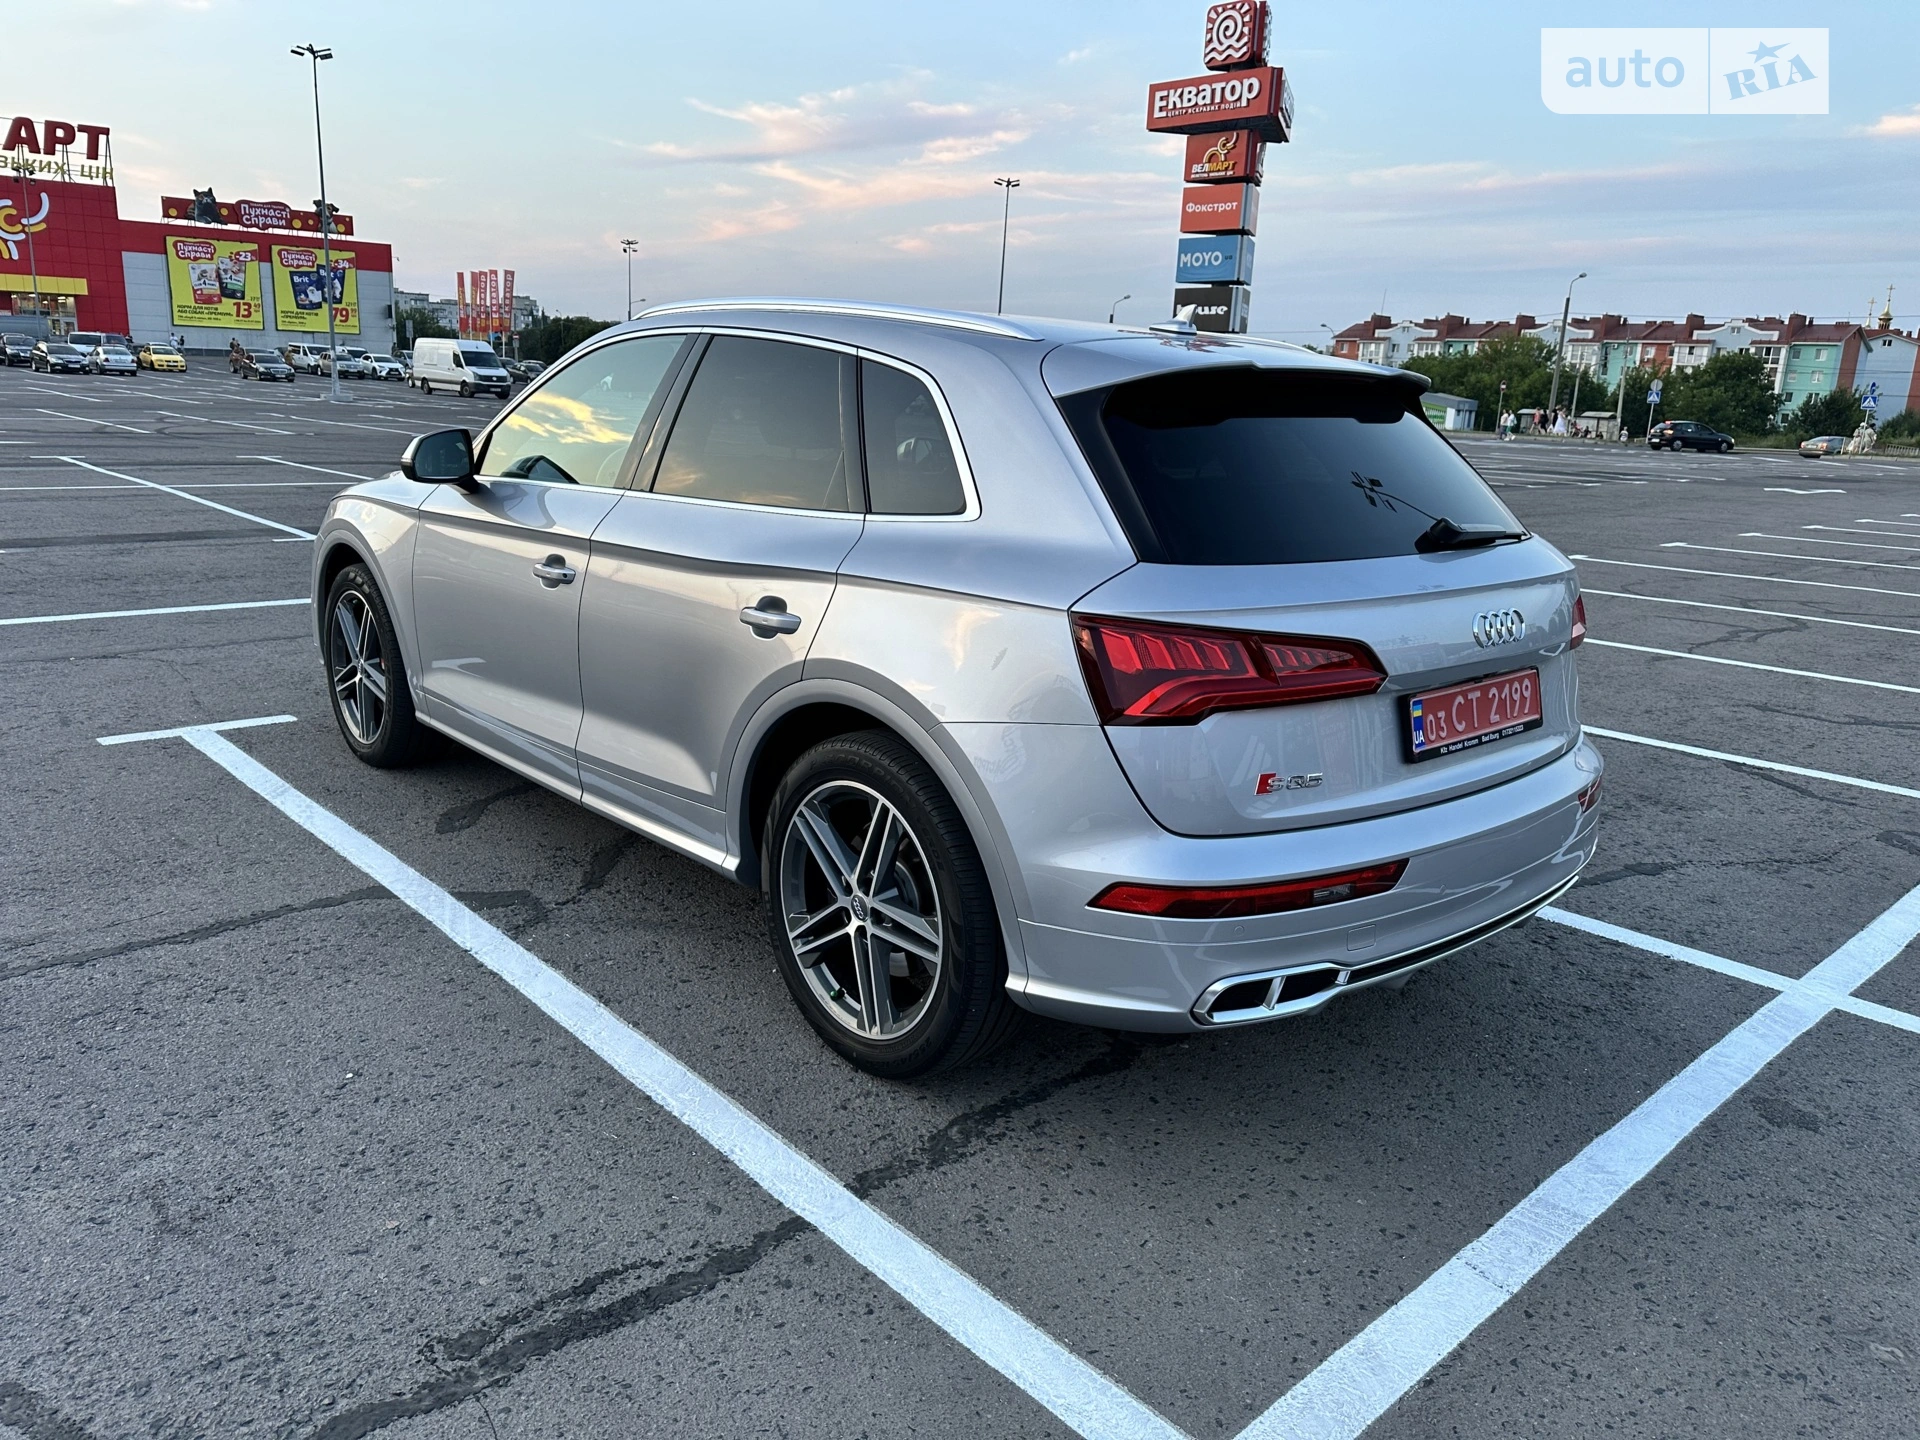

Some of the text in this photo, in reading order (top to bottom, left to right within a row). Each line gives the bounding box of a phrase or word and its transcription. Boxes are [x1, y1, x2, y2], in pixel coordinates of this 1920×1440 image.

[1153, 77, 1260, 118] Екватор
[1167, 109, 1186, 118] ЦЕНТР
[1187, 105, 1219, 114] ЯСКРАВИХ
[2, 116, 110, 160] АРТ
[1192, 161, 1235, 173] ВЕЛМАРТ
[241, 204, 290, 218] Пухнасті
[1185, 202, 1238, 213] Фокстрот
[243, 215, 286, 228] Справи
[177, 243, 214, 254] Пухнасті
[178, 251, 211, 260] Справи
[281, 251, 315, 261] Пухнасті
[1180, 251, 1222, 268] MOYO
[282, 259, 313, 267] Справи
[293, 275, 309, 283] Brit
[233, 302, 252, 318] 13
[1176, 304, 1228, 315] huse
[1426, 710, 1447, 741] 03
[1488, 678, 1532, 724] 2199
[1414, 731, 1425, 744] UA
[1449, 742, 1463, 752] Handel
[1266, 772, 1323, 791] SQ5
